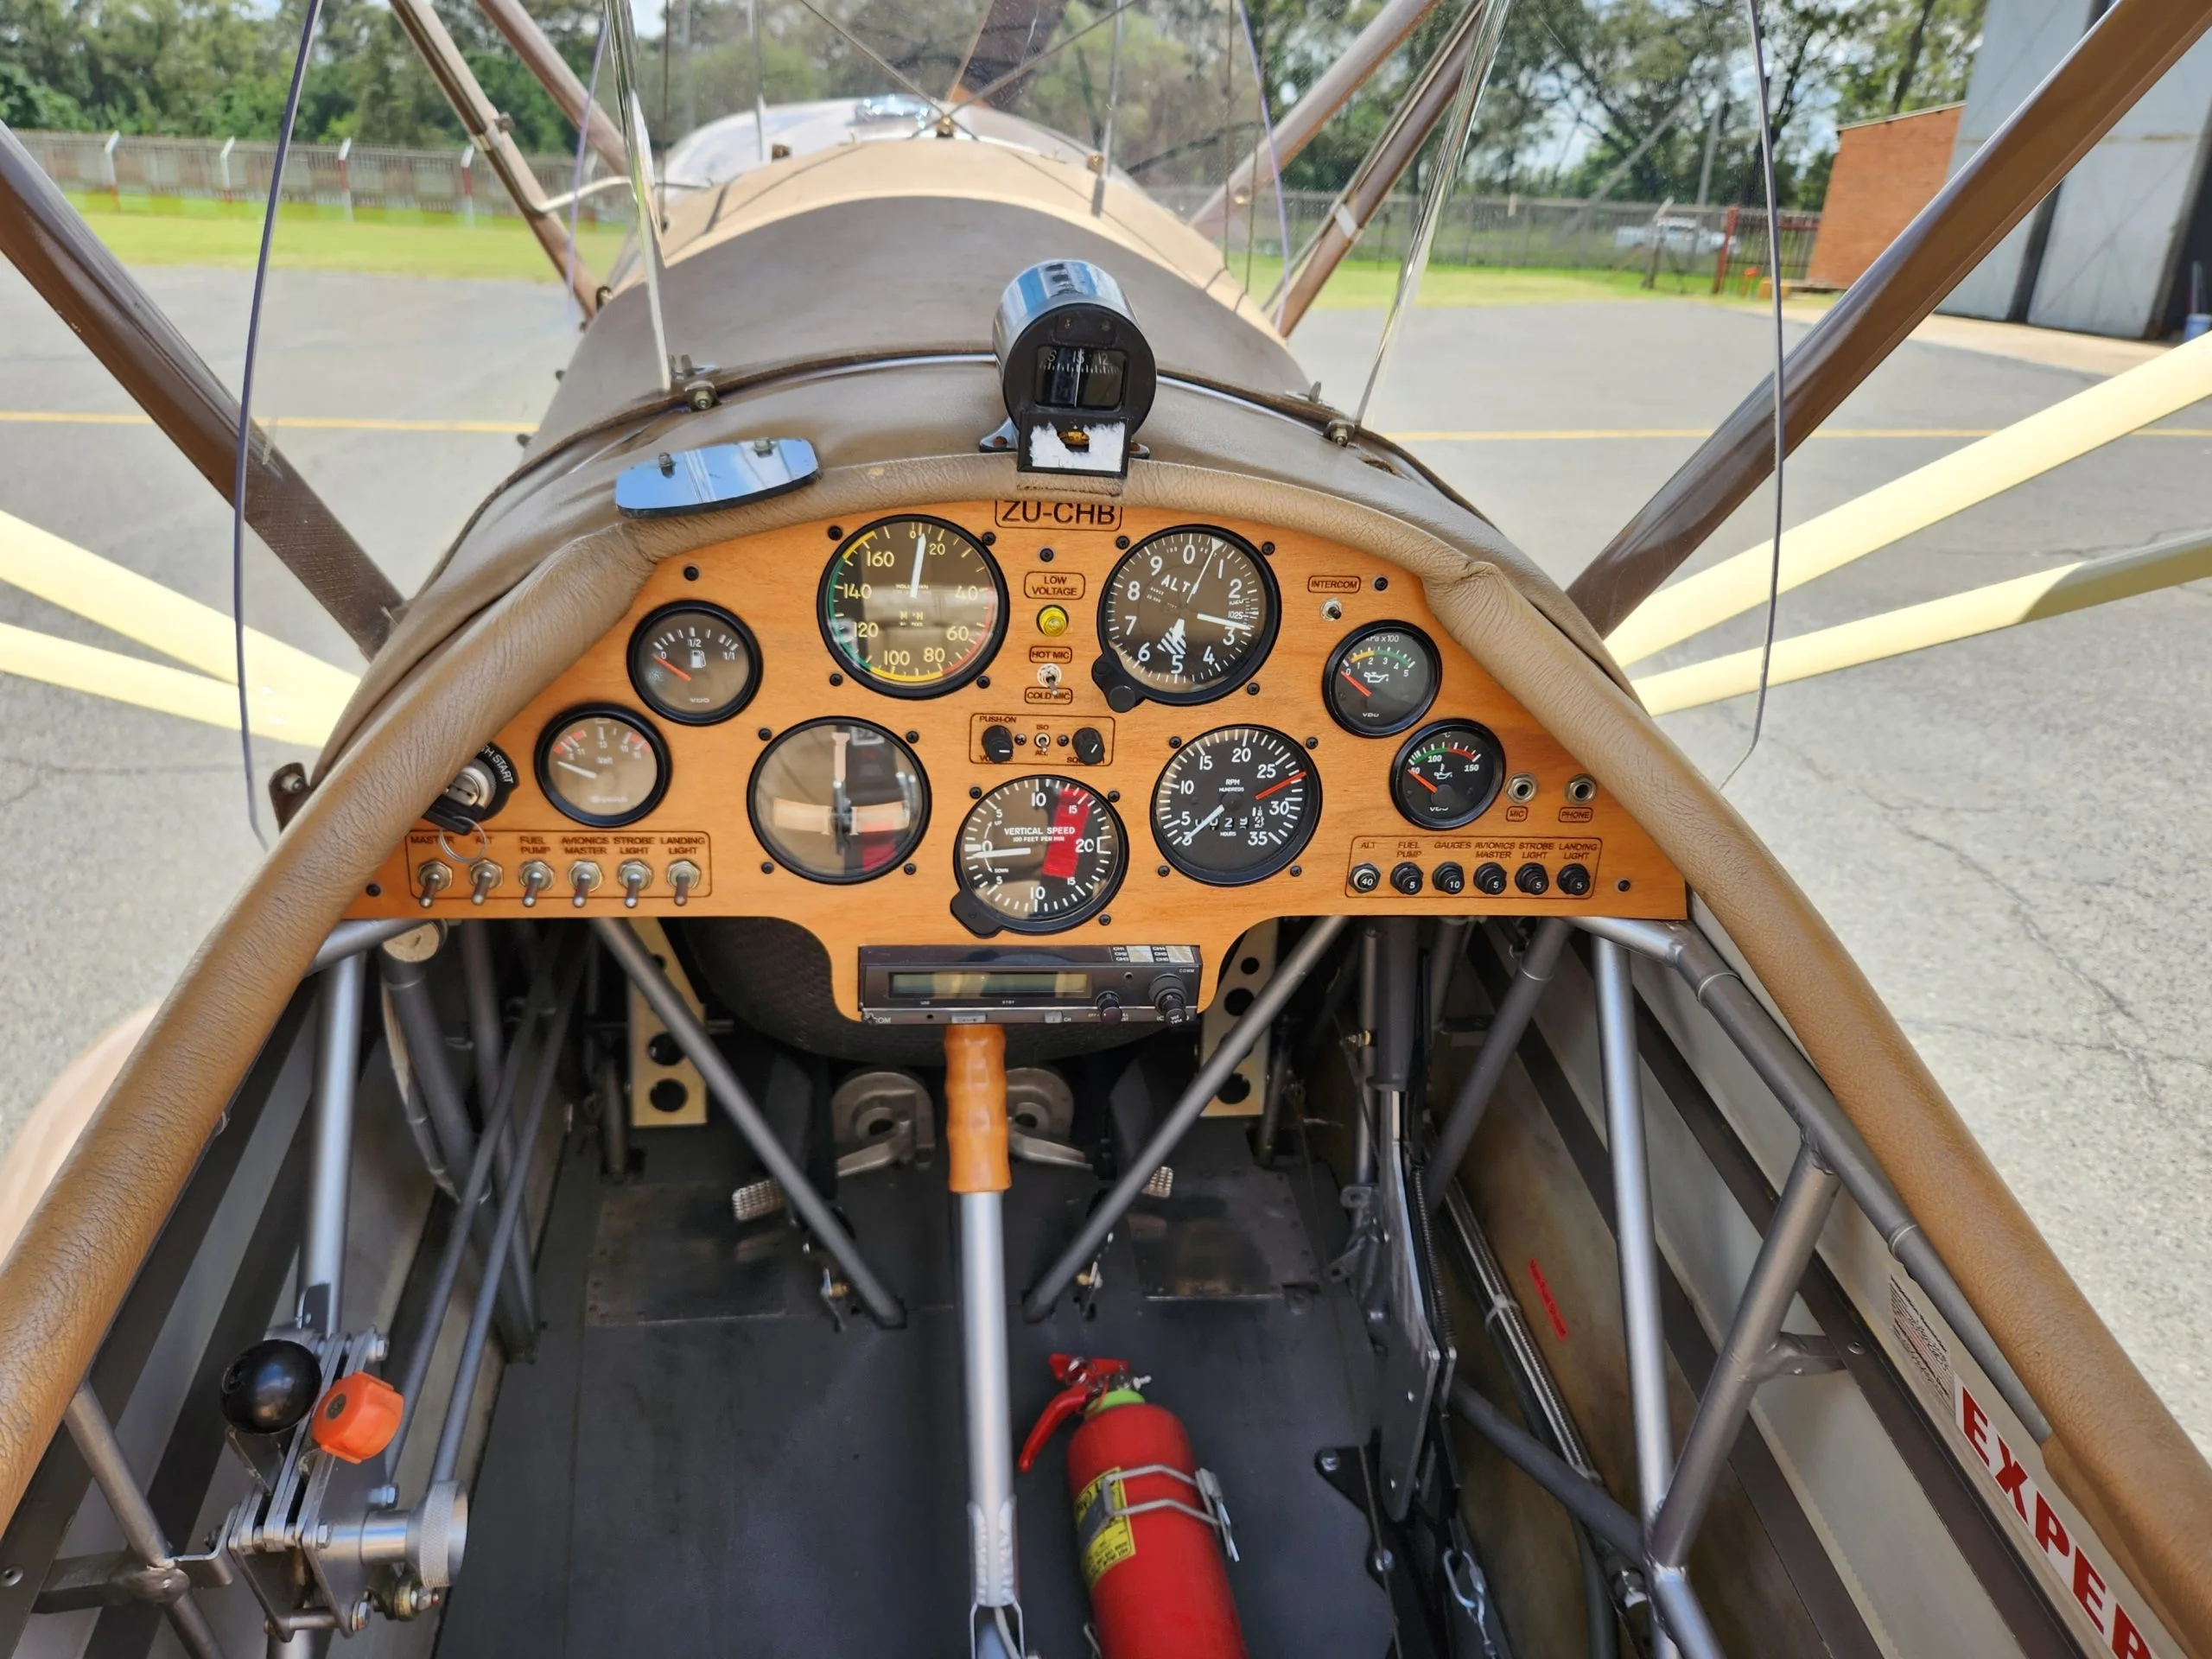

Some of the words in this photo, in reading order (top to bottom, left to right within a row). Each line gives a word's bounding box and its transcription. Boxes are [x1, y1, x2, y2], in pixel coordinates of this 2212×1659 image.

[1047, 350, 1058, 362] S
[1098, 352, 1108, 365] 12
[1001, 500, 1115, 524] ZU-CHB
[929, 543, 945, 556] 20
[1183, 544, 1196, 564] 0
[867, 550, 894, 567] 160
[1150, 556, 1163, 576] 9
[1218, 559, 1224, 579] 1
[1044, 575, 1067, 584] LOW
[1161, 574, 1191, 593] ALT
[843, 584, 872, 599] 140
[955, 585, 979, 601] 40
[1032, 587, 1077, 596] VOLTAGE
[1128, 581, 1141, 601] 8
[1229, 578, 1243, 598] 2
[1228, 611, 1243, 620] 1025
[853, 622, 879, 638] 120
[1124, 615, 1137, 635] 7
[947, 626, 969, 641] 60
[1223, 626, 1236, 646] 3
[688, 639, 702, 647] 1/2
[661, 651, 666, 659] 0
[722, 652, 735, 660] 1/1
[884, 651, 910, 665] 100
[924, 648, 945, 662] 80
[1138, 642, 1151, 662] 6
[1203, 645, 1215, 665] 4
[1171, 655, 1184, 674] 5
[1199, 755, 1213, 770] 15
[1231, 747, 1251, 763] 20
[493, 754, 513, 784] START
[1256, 764, 1276, 779] 25
[1180, 780, 1194, 794] 10
[1031, 792, 1046, 806] 10
[996, 809, 1002, 817] 5
[1069, 805, 1077, 814] 15
[1269, 801, 1290, 816] 30
[1560, 810, 1591, 819] PHONE
[1181, 811, 1191, 825] 5
[1004, 827, 1043, 836] VERTICAL
[1248, 831, 1268, 846] 35
[982, 840, 993, 851] 0
[1076, 839, 1094, 853] 20
[996, 876, 1003, 885] 5
[1067, 877, 1076, 886] 15
[1030, 886, 1046, 900] 10
